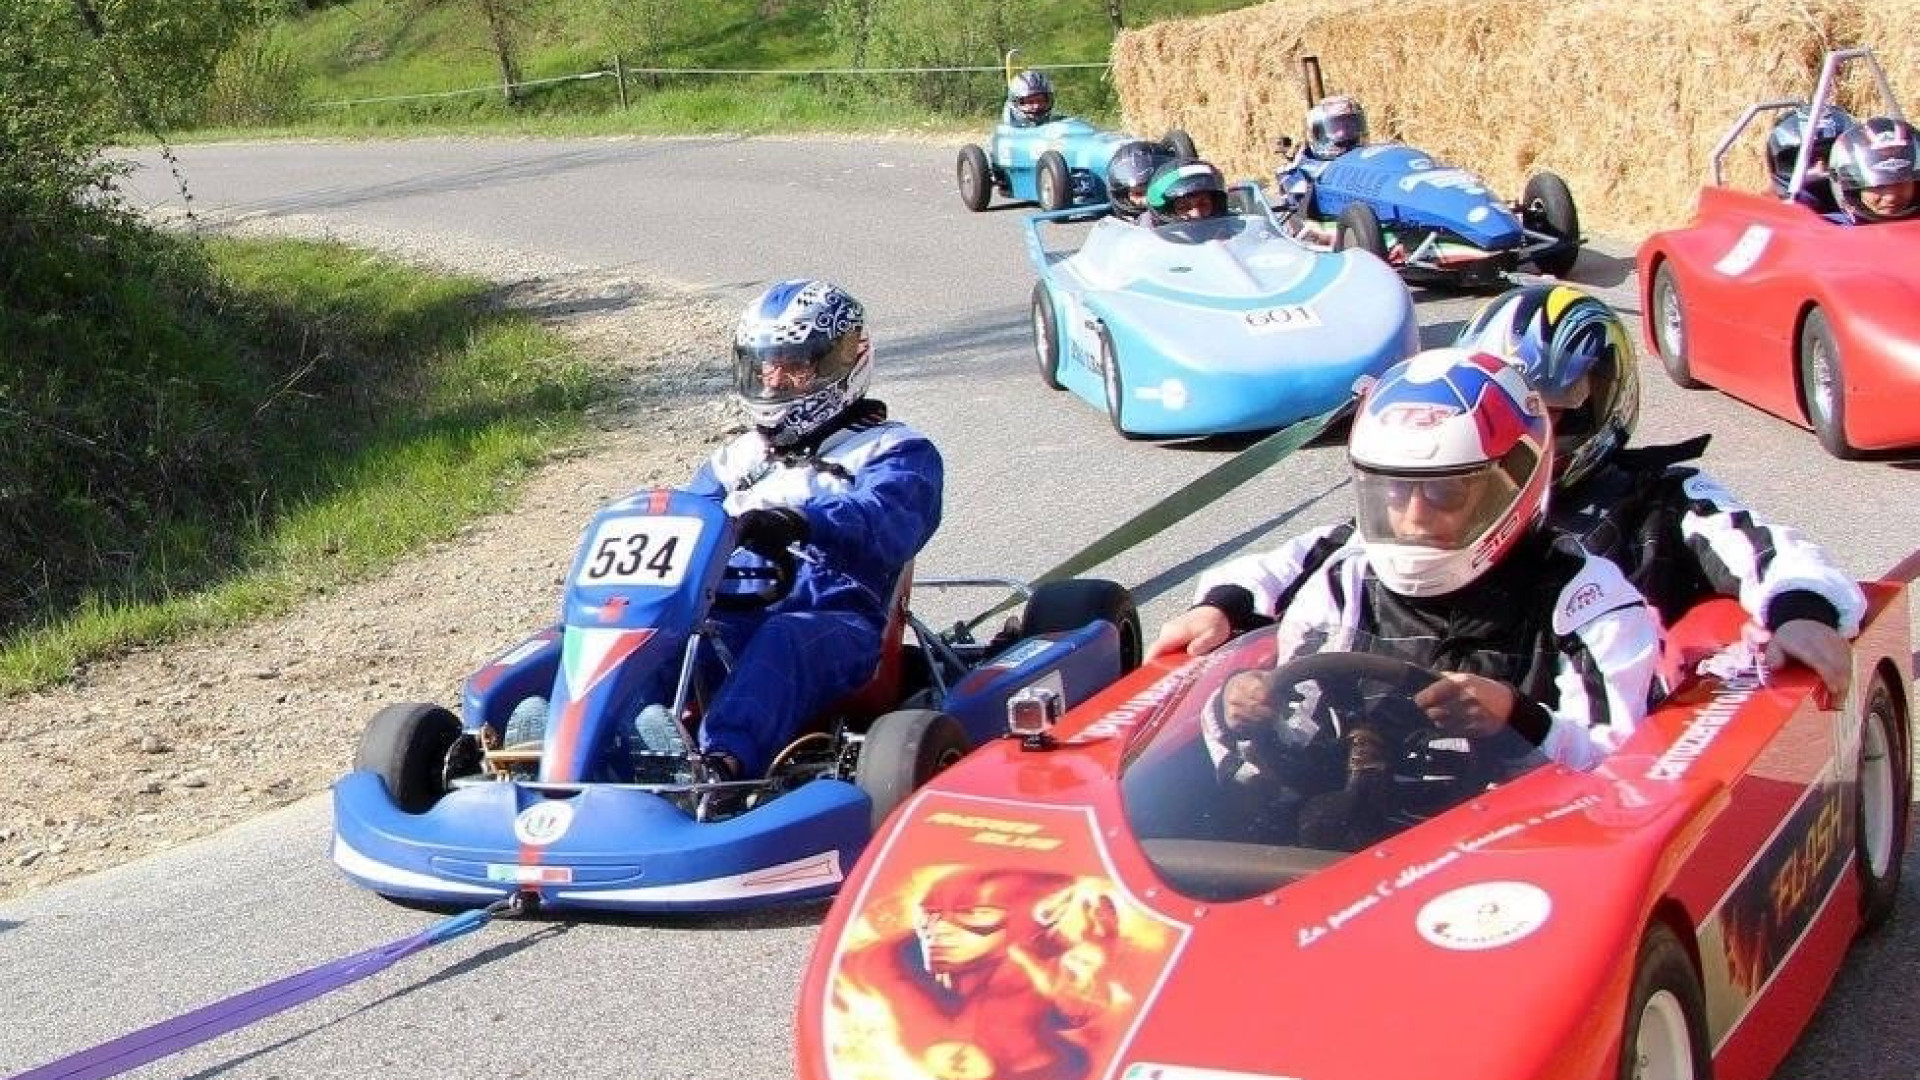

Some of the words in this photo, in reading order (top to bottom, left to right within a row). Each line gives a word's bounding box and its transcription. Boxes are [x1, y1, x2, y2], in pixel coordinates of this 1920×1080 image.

[1244, 306, 1311, 327] 601
[589, 533, 680, 579] 534
[1771, 786, 1842, 922] FLASH
